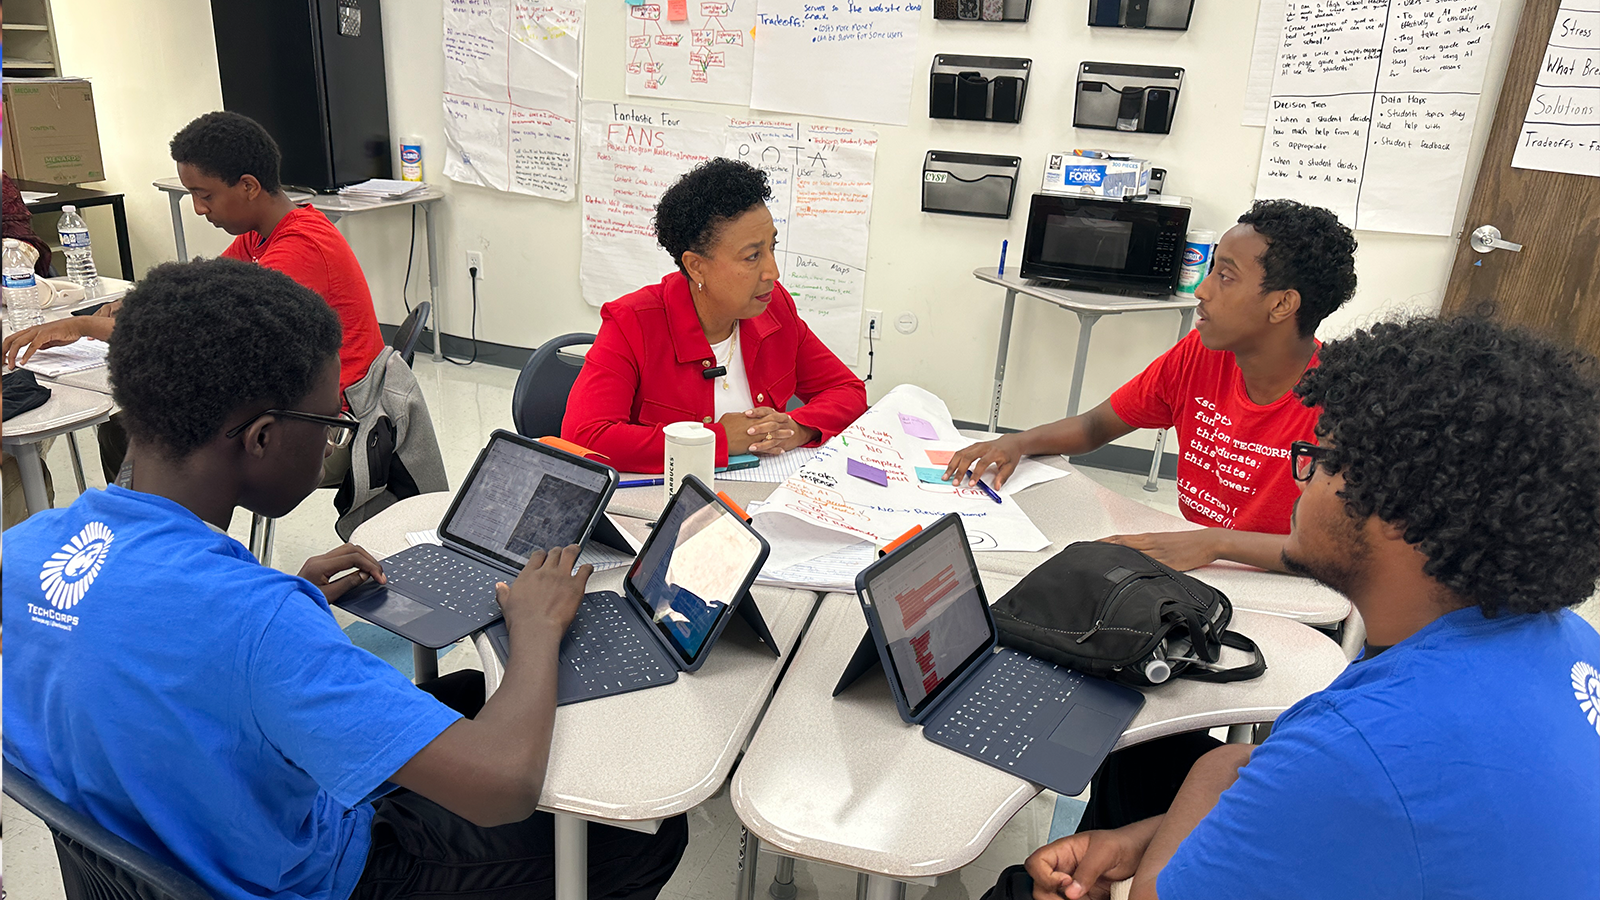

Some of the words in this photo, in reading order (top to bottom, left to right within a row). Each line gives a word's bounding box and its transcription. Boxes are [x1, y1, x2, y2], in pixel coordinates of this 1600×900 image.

[1403, 12, 1414, 20] To
[1457, 26, 1471, 35] the
[1560, 18, 1592, 38] Stress
[1546, 54, 1578, 76] What
[1582, 57, 1600, 78] Bre
[1273, 100, 1307, 110] Decision
[1380, 95, 1402, 105] Data
[1533, 93, 1595, 116] Solutions
[612, 103, 654, 125] Fantastic
[661, 112, 681, 127] Four
[1314, 127, 1330, 137] help
[1404, 120, 1419, 131] help
[607, 123, 665, 149] FANS
[1381, 137, 1413, 149] Student
[1525, 131, 1575, 151] Tradeoffs
[925, 172, 947, 182] CYSP
[1069, 171, 1102, 182] FORKS
[796, 255, 820, 268] Data
[830, 263, 851, 276] Maps
[1195, 396, 1233, 426] <scpt>
[27, 602, 80, 627] TECHCORPS
